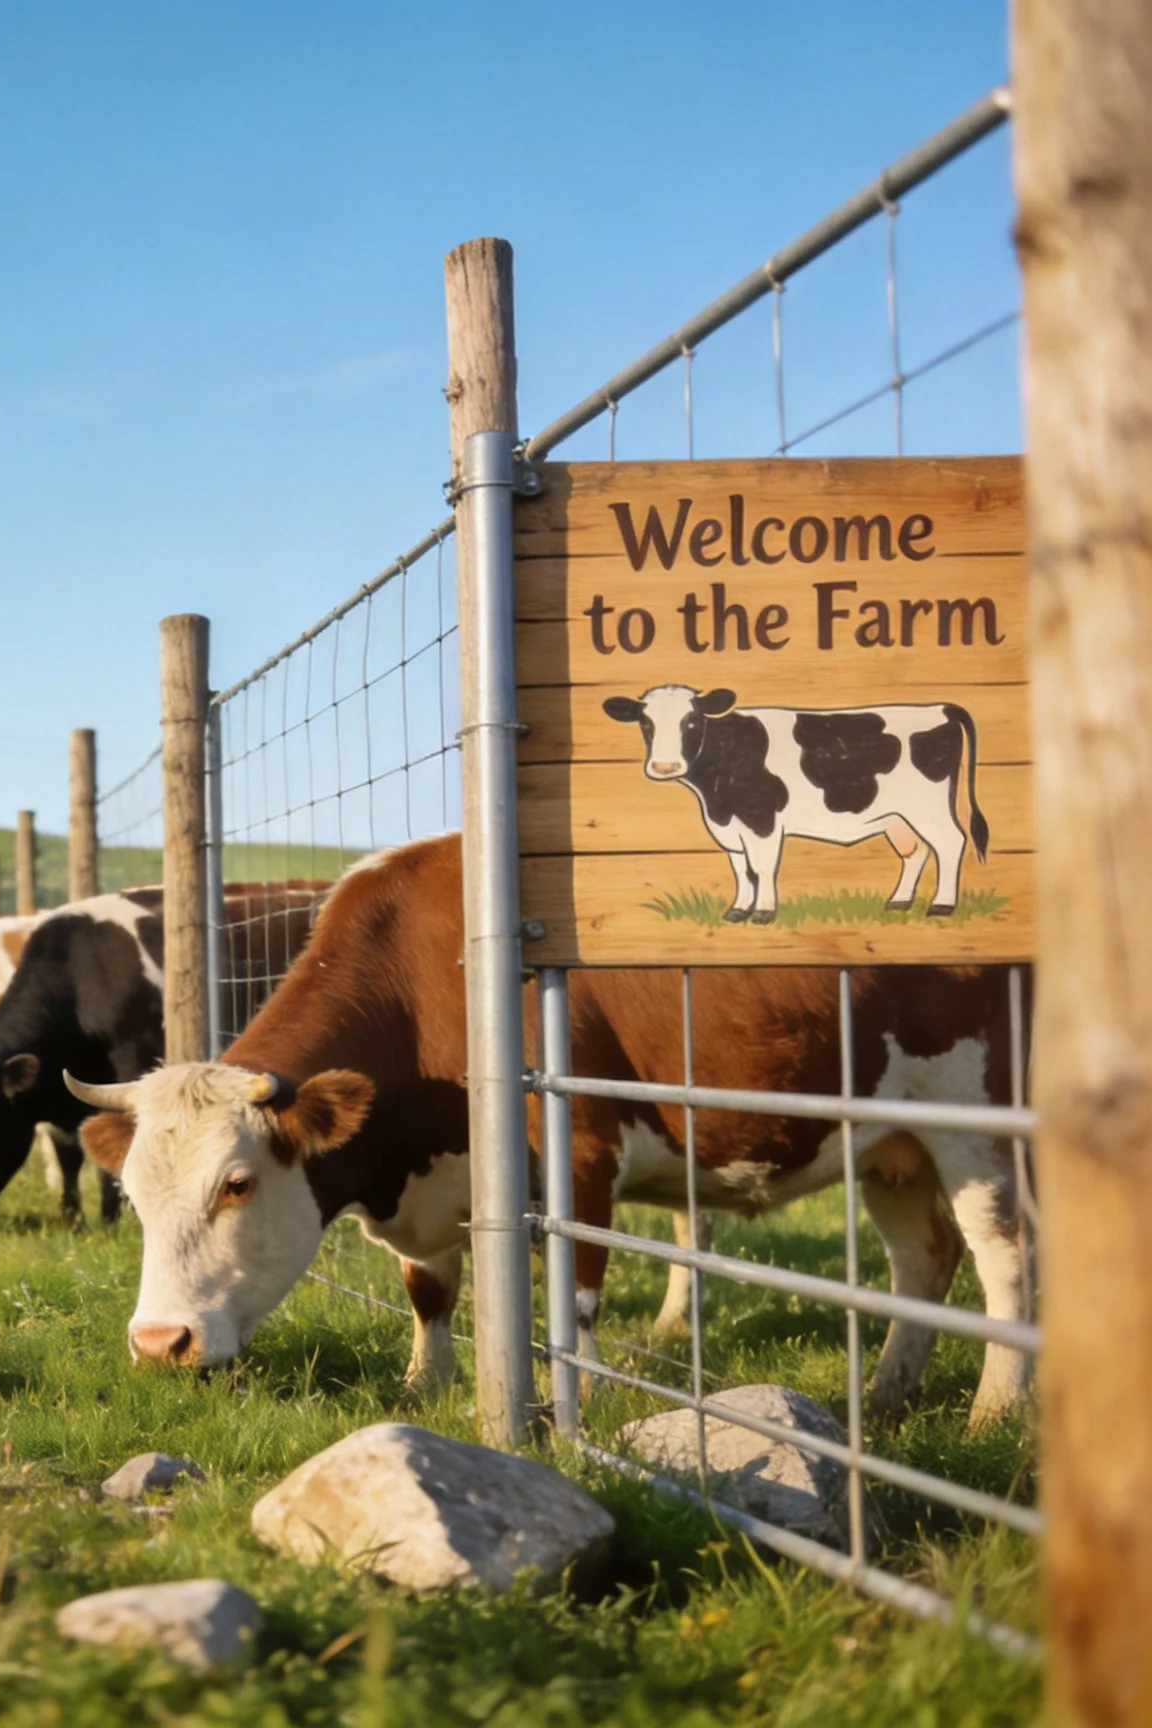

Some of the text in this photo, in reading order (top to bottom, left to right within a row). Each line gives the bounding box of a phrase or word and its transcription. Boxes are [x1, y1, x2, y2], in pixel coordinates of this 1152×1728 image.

[608, 494, 936, 571] Welcome
[583, 580, 1006, 654] to the Farm
